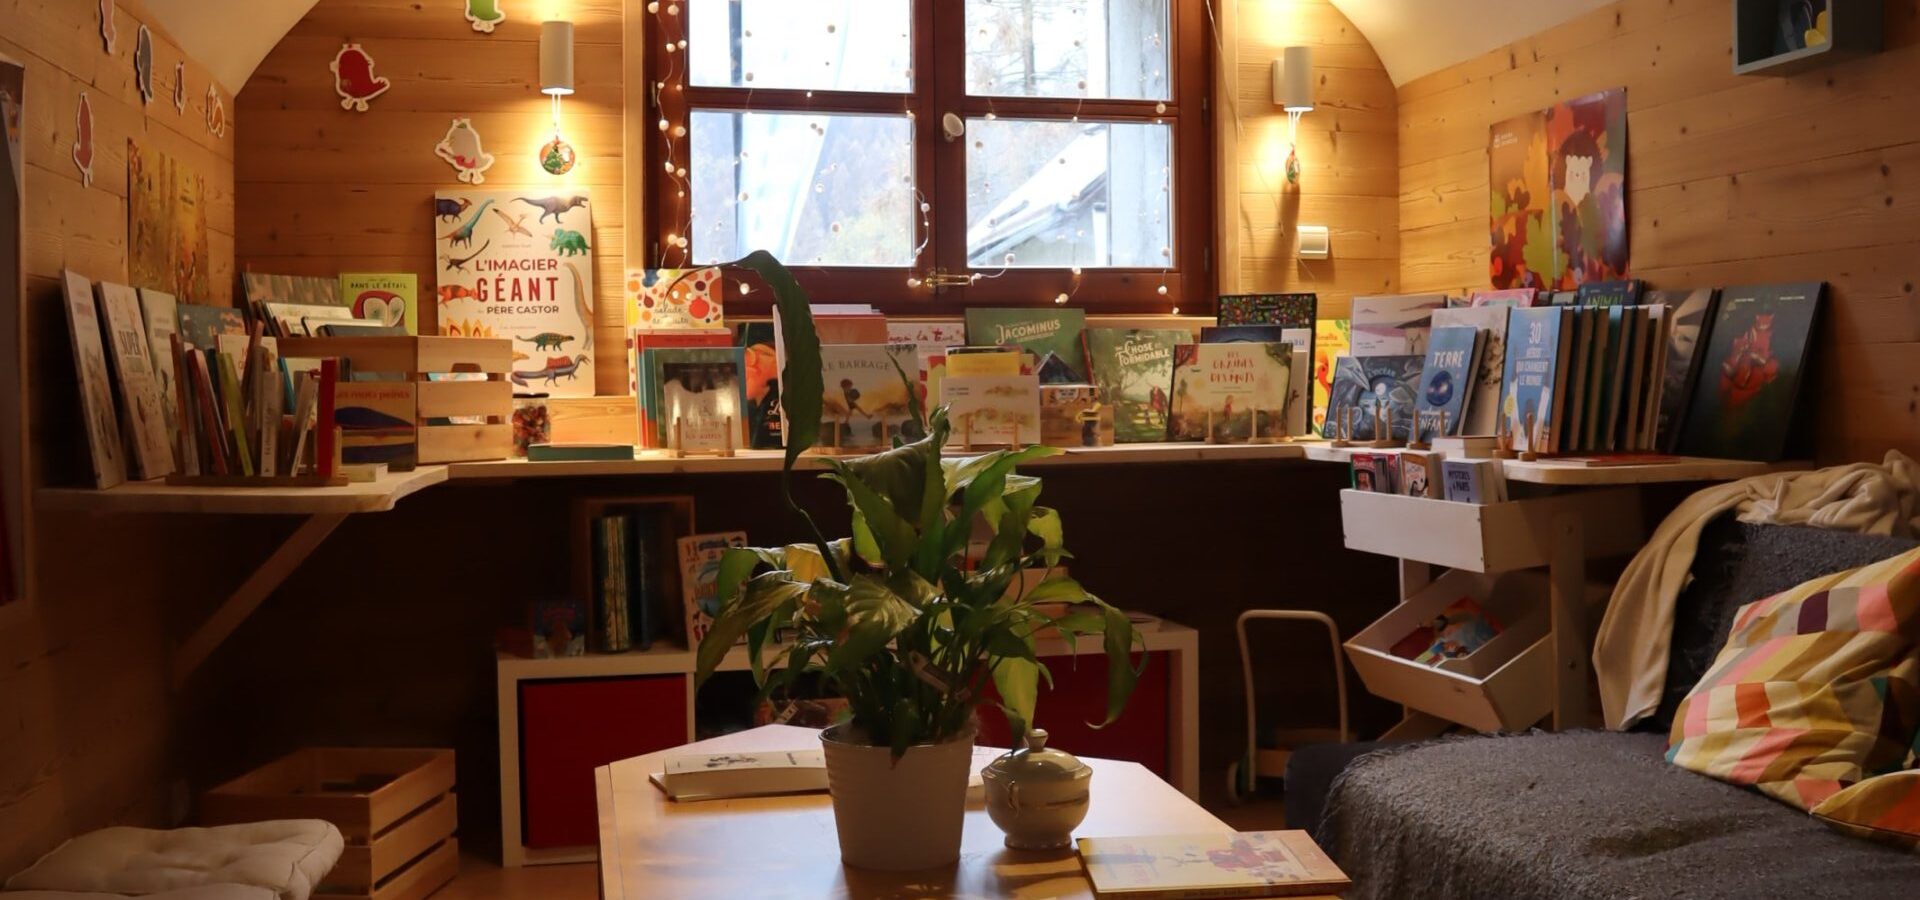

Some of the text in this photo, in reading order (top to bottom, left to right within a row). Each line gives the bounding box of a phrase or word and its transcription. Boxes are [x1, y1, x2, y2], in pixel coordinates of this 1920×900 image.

[476, 258, 558, 271] L'IMAGIER
[477, 273, 559, 302] GÉANT
[516, 305, 559, 315] CASTOR
[995, 319, 1061, 346] JACOMINUS
[1528, 321, 1542, 346] 30
[1124, 340, 1154, 356] CHOSE
[839, 359, 892, 371] BARRAGE
[1114, 347, 1170, 368] FORMIDABLE
[1433, 350, 1465, 368] TERRE
